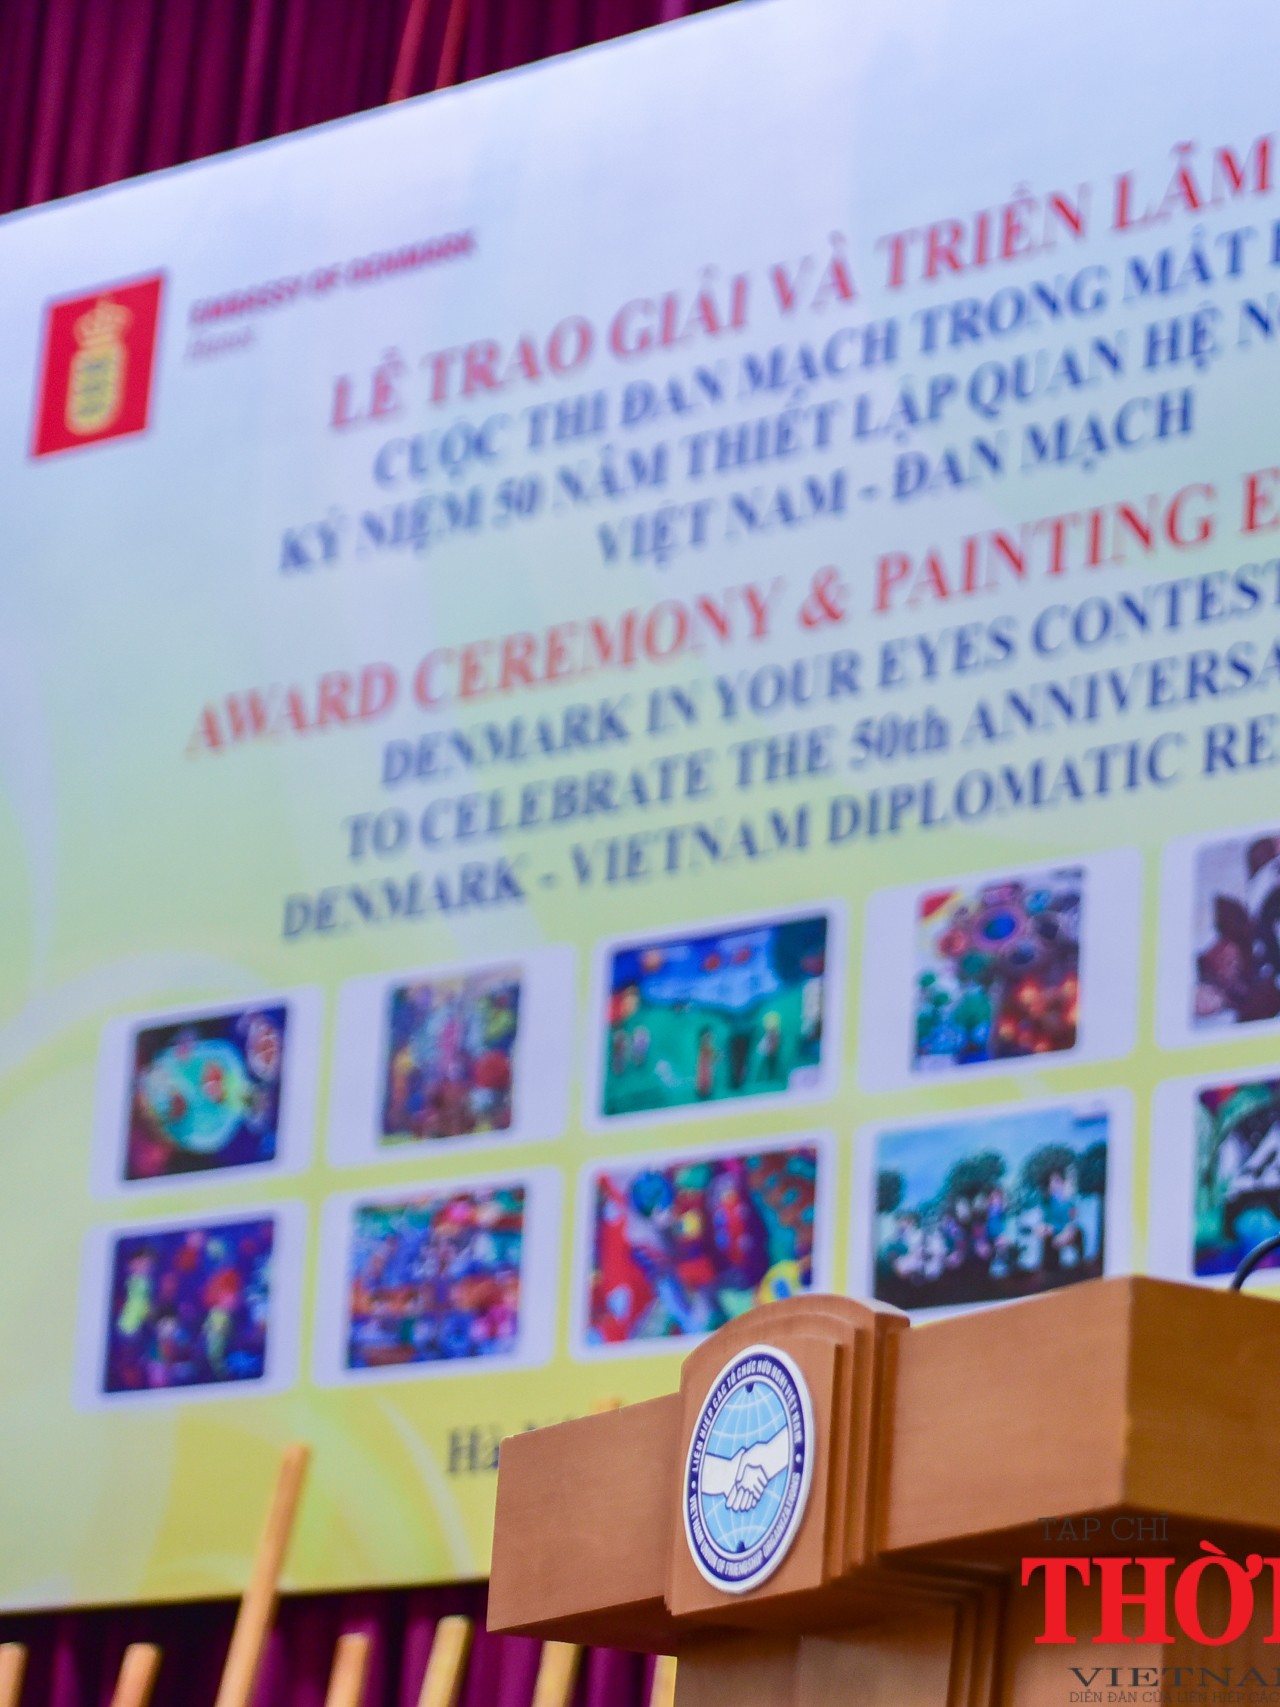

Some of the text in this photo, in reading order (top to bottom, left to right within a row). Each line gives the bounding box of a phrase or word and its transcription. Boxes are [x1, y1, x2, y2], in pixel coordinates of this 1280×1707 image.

[423, 314, 596, 406] TRAO
[608, 266, 750, 361] GIẢI
[770, 231, 858, 314] VÀ
[1108, 130, 1277, 233] LÃM
[525, 392, 607, 454] THI
[915, 264, 1108, 356] TRONG
[494, 470, 544, 525] 50
[966, 335, 1130, 420] QUAN
[729, 467, 850, 536] NAM
[892, 434, 1004, 503] ĐAN
[1020, 385, 1196, 474] MẠCH
[187, 662, 399, 757] AWARD
[412, 577, 783, 708] CEREMONY
[799, 566, 850, 631] &
[875, 481, 1217, 618] PAINTING
[380, 704, 631, 787] DENMARK
[645, 684, 702, 737] IN
[711, 648, 864, 727] YOUR
[877, 612, 1017, 691] EYES
[281, 855, 525, 941] DENMARK
[569, 801, 811, 892] VIETNAM
[826, 729, 1184, 847] DIPLOMATIC
[343, 807, 403, 865] TO
[419, 747, 719, 851] CELEBRATE
[731, 722, 841, 790] THE
[850, 704, 950, 769] 50th
